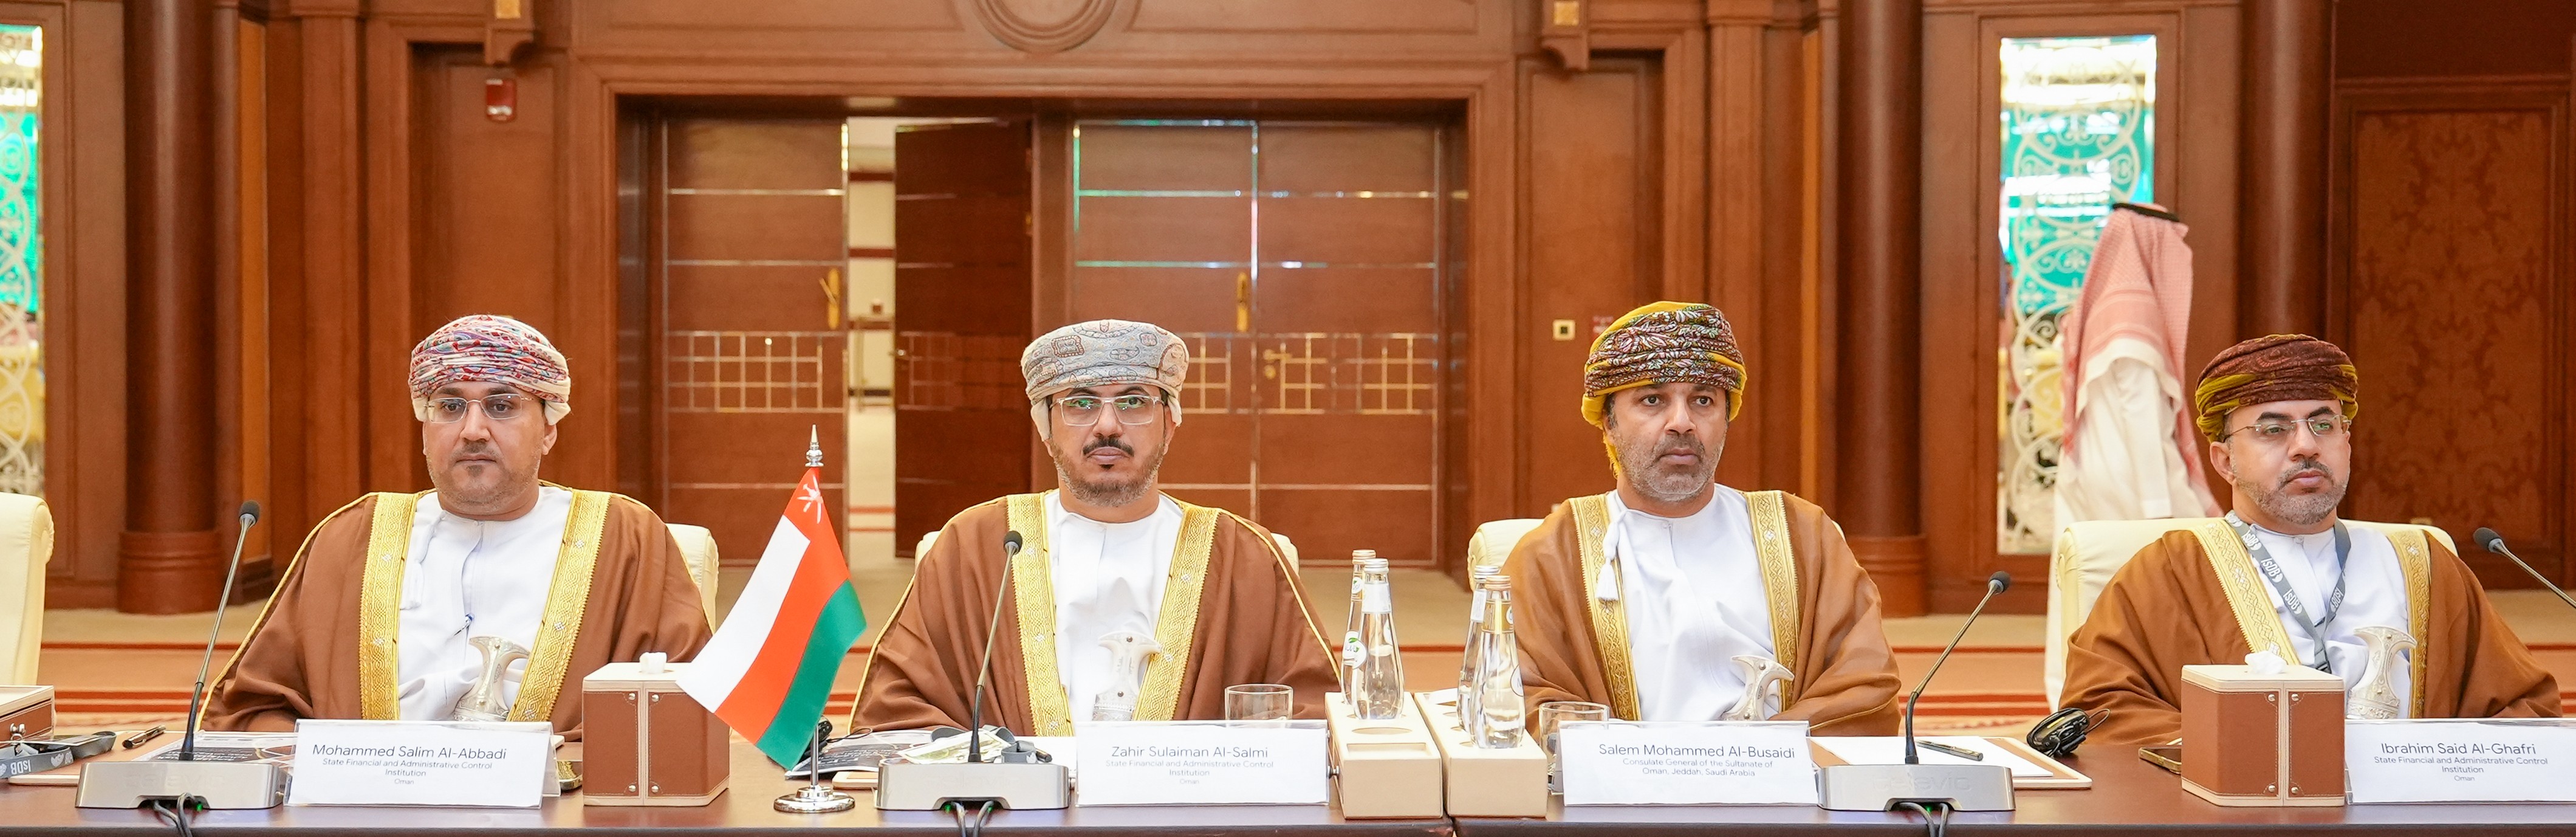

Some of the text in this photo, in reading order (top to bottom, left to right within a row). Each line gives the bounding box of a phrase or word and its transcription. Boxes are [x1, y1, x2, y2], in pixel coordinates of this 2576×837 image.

[2261, 558, 2282, 577] IsDB
[2283, 588, 2301, 610] IsDB
[313, 744, 507, 759] Mohammed Salim Al-Abbadi
[1112, 746, 1268, 758] Zahir Sulaiman Al-Salmi
[1599, 744, 1795, 758] Salem Mohammed Al-Busaidi
[2381, 743, 2536, 754] Ibrahim Said Al-Ghafri
[10, 759, 32, 775] IsDB
